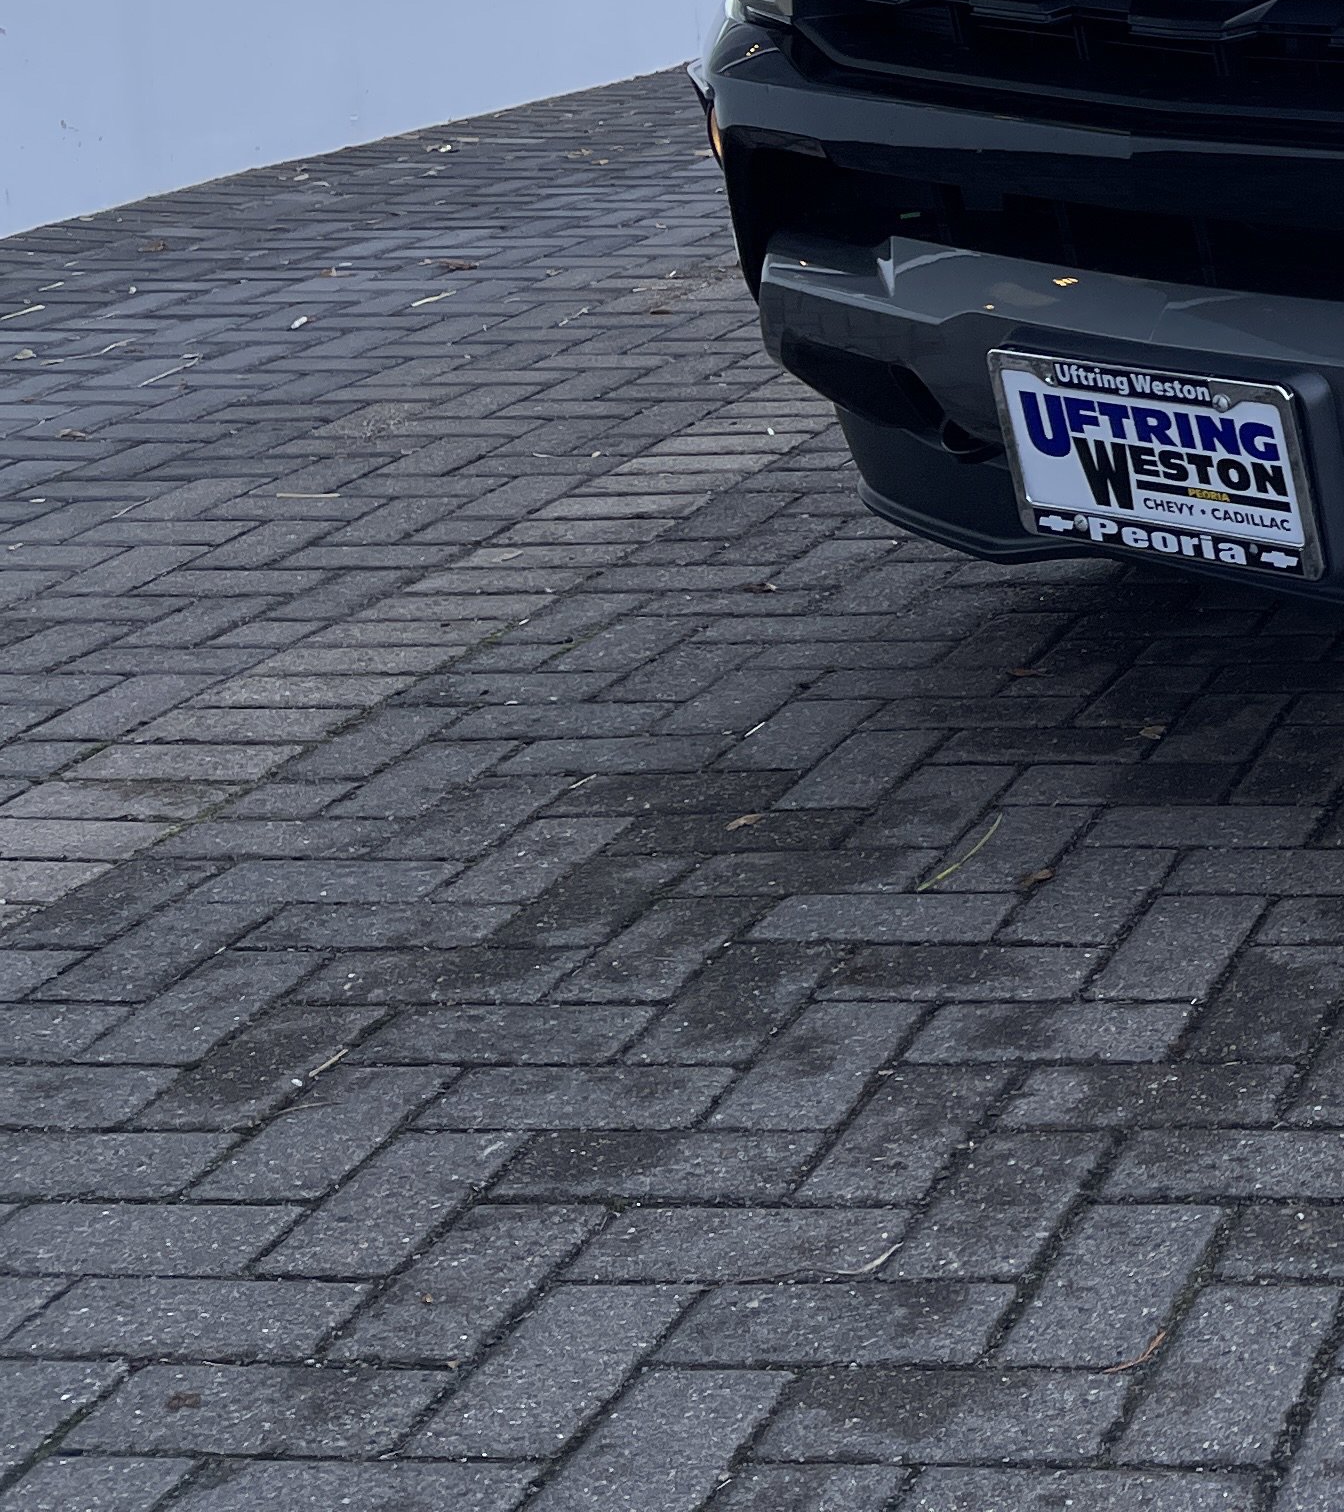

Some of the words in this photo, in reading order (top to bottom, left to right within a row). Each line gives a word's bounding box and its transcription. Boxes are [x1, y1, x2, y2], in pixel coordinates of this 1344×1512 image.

[1054, 363, 1130, 395] Uftring
[1130, 373, 1211, 402] Weston
[1018, 390, 1281, 462] UFTRING
[1071, 436, 1291, 511] WESTON
[1187, 487, 1231, 503] PEORIA
[1143, 497, 1195, 517] CHEVY
[1211, 507, 1293, 533] CADILLAC
[1087, 517, 1248, 566] Peoria
